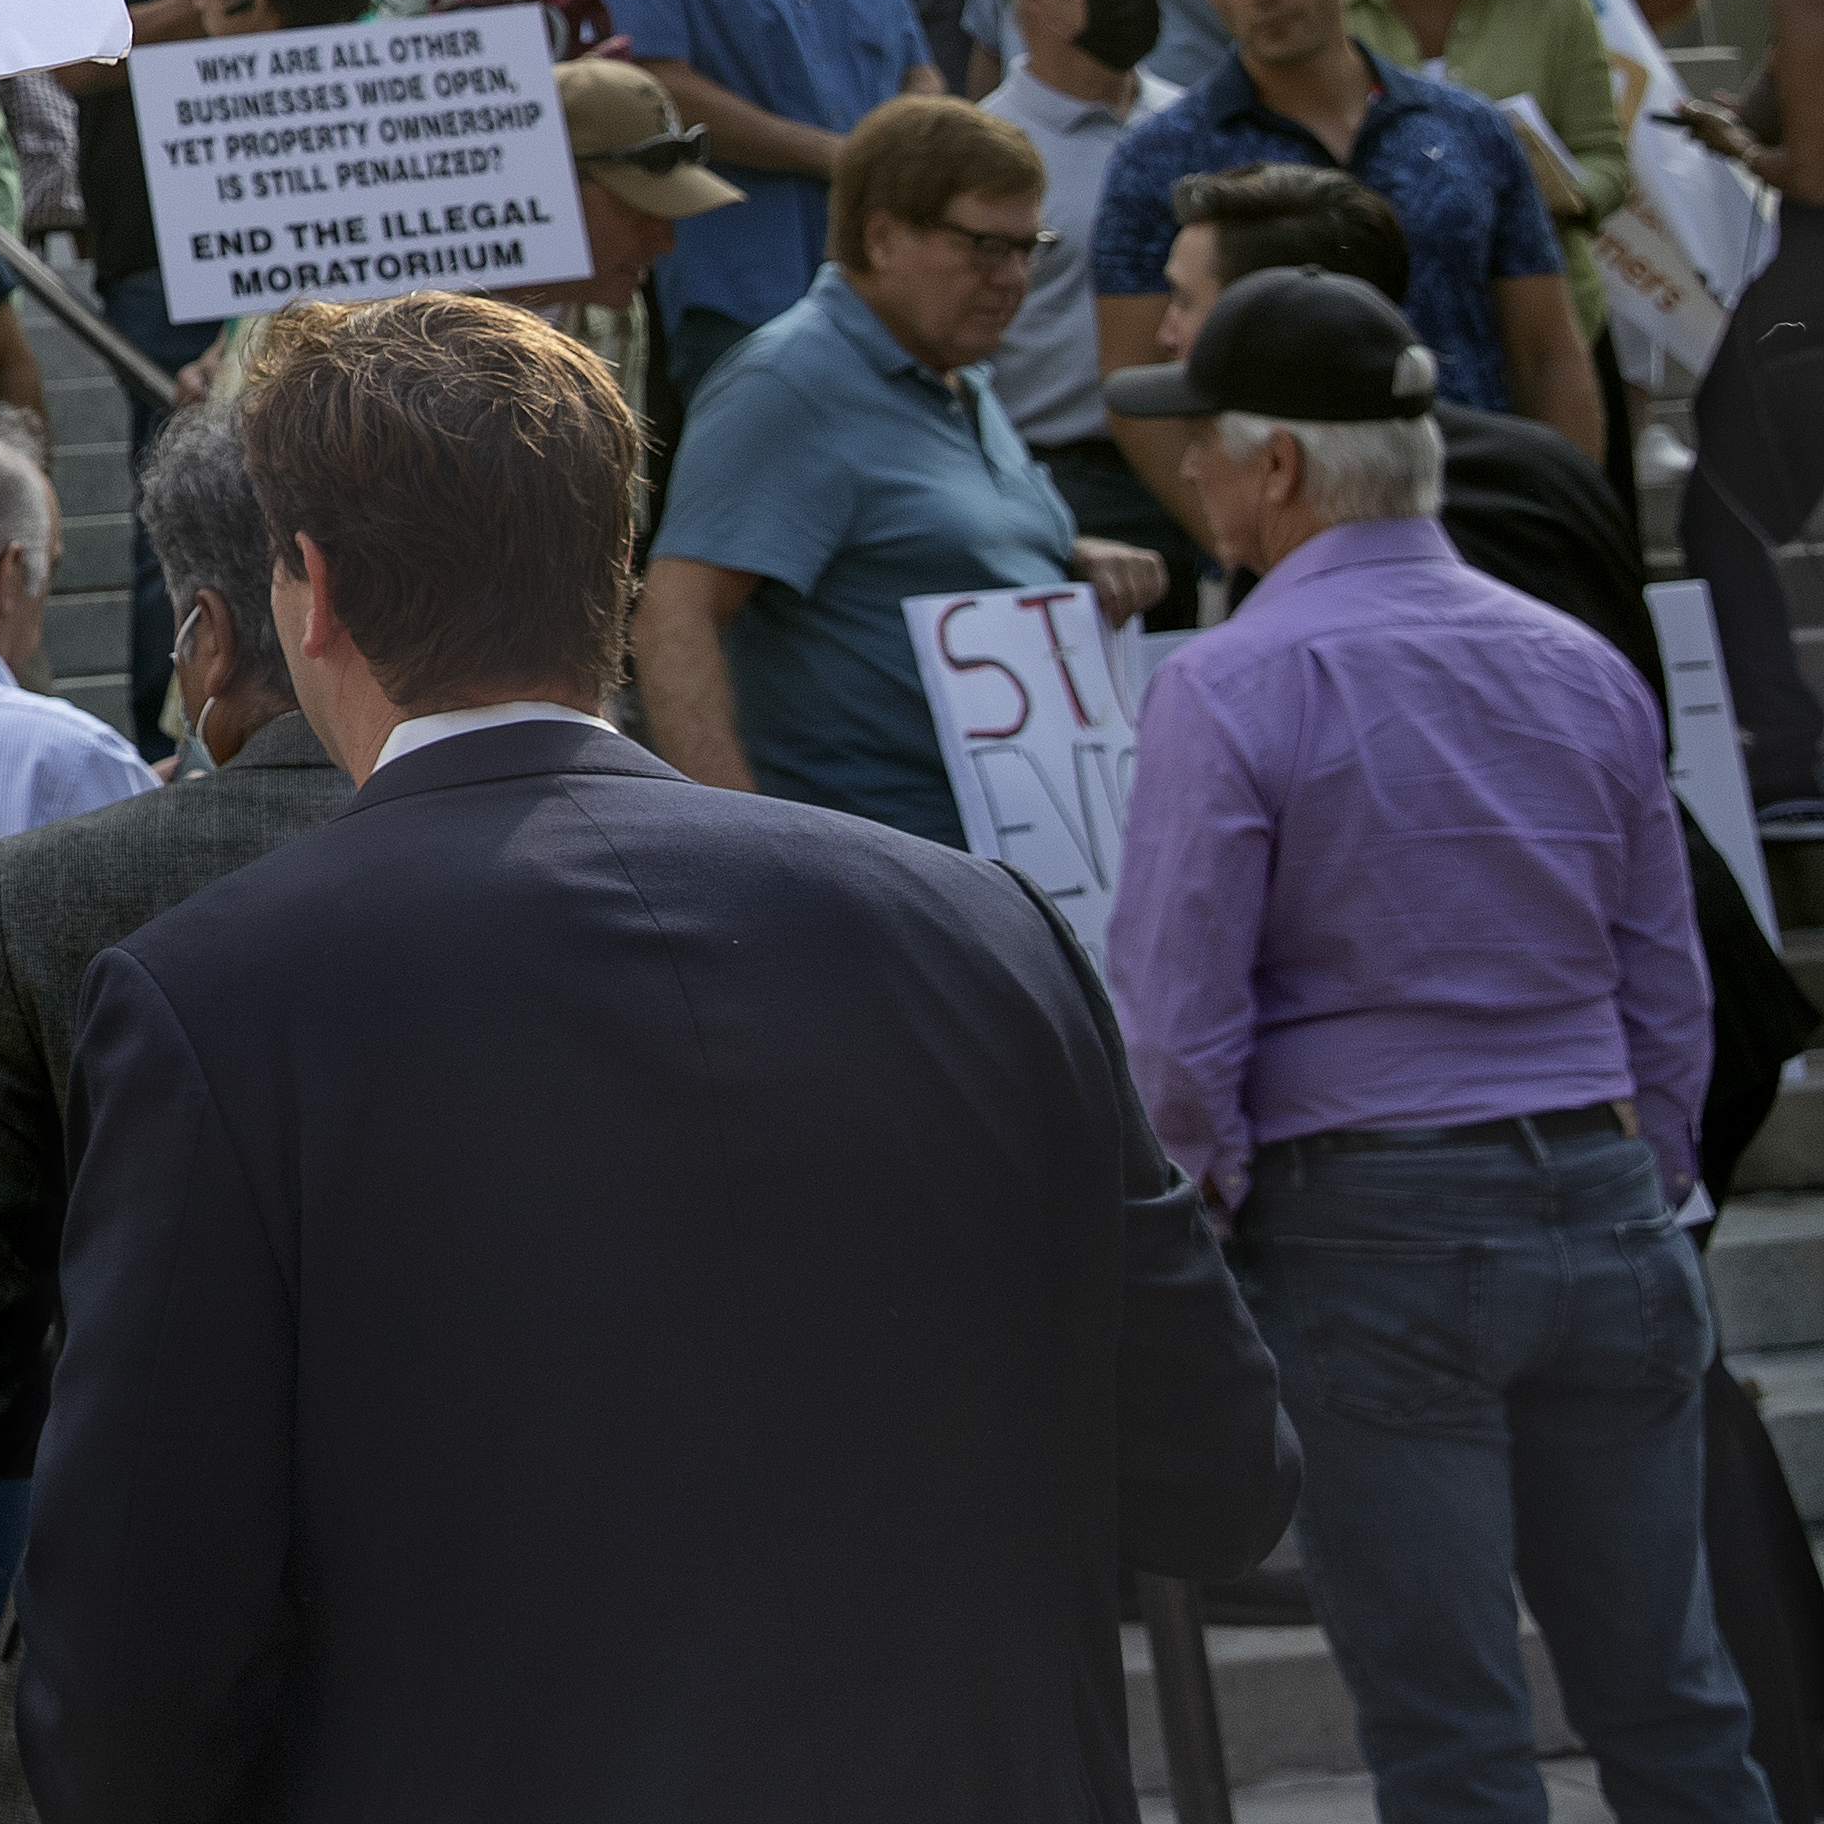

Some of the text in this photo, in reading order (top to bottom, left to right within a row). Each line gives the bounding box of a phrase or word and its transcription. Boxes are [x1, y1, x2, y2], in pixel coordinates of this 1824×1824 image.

[196, 29, 484, 83] WHY ARE ALL OTHER
[175, 82, 349, 126] BUSINESSES
[355, 74, 424, 106] WIDE
[163, 103, 545, 168] YET PROPERTY OWNERSHIP
[216, 146, 505, 202] IS STILL PENALIZED?
[190, 196, 554, 261] END THE ILLEGAL
